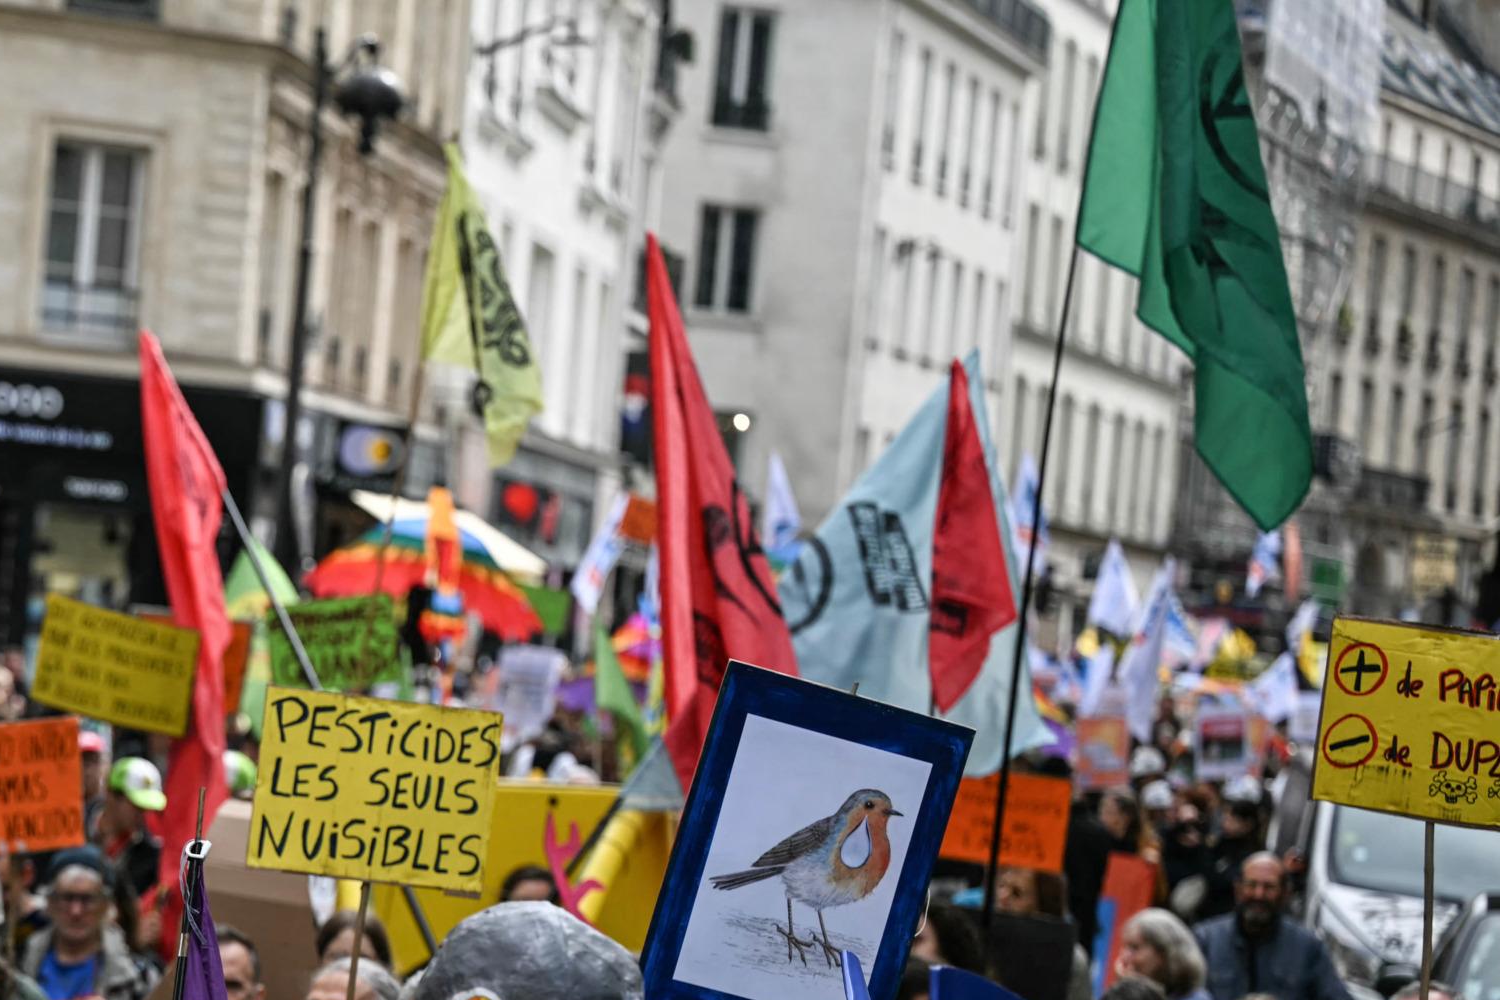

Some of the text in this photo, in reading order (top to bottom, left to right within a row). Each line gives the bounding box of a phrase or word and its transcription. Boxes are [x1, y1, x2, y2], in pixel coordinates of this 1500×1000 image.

[1396, 660, 1424, 698] de
[1384, 734, 1413, 768] de
[270, 757, 479, 815] LES SEULS
